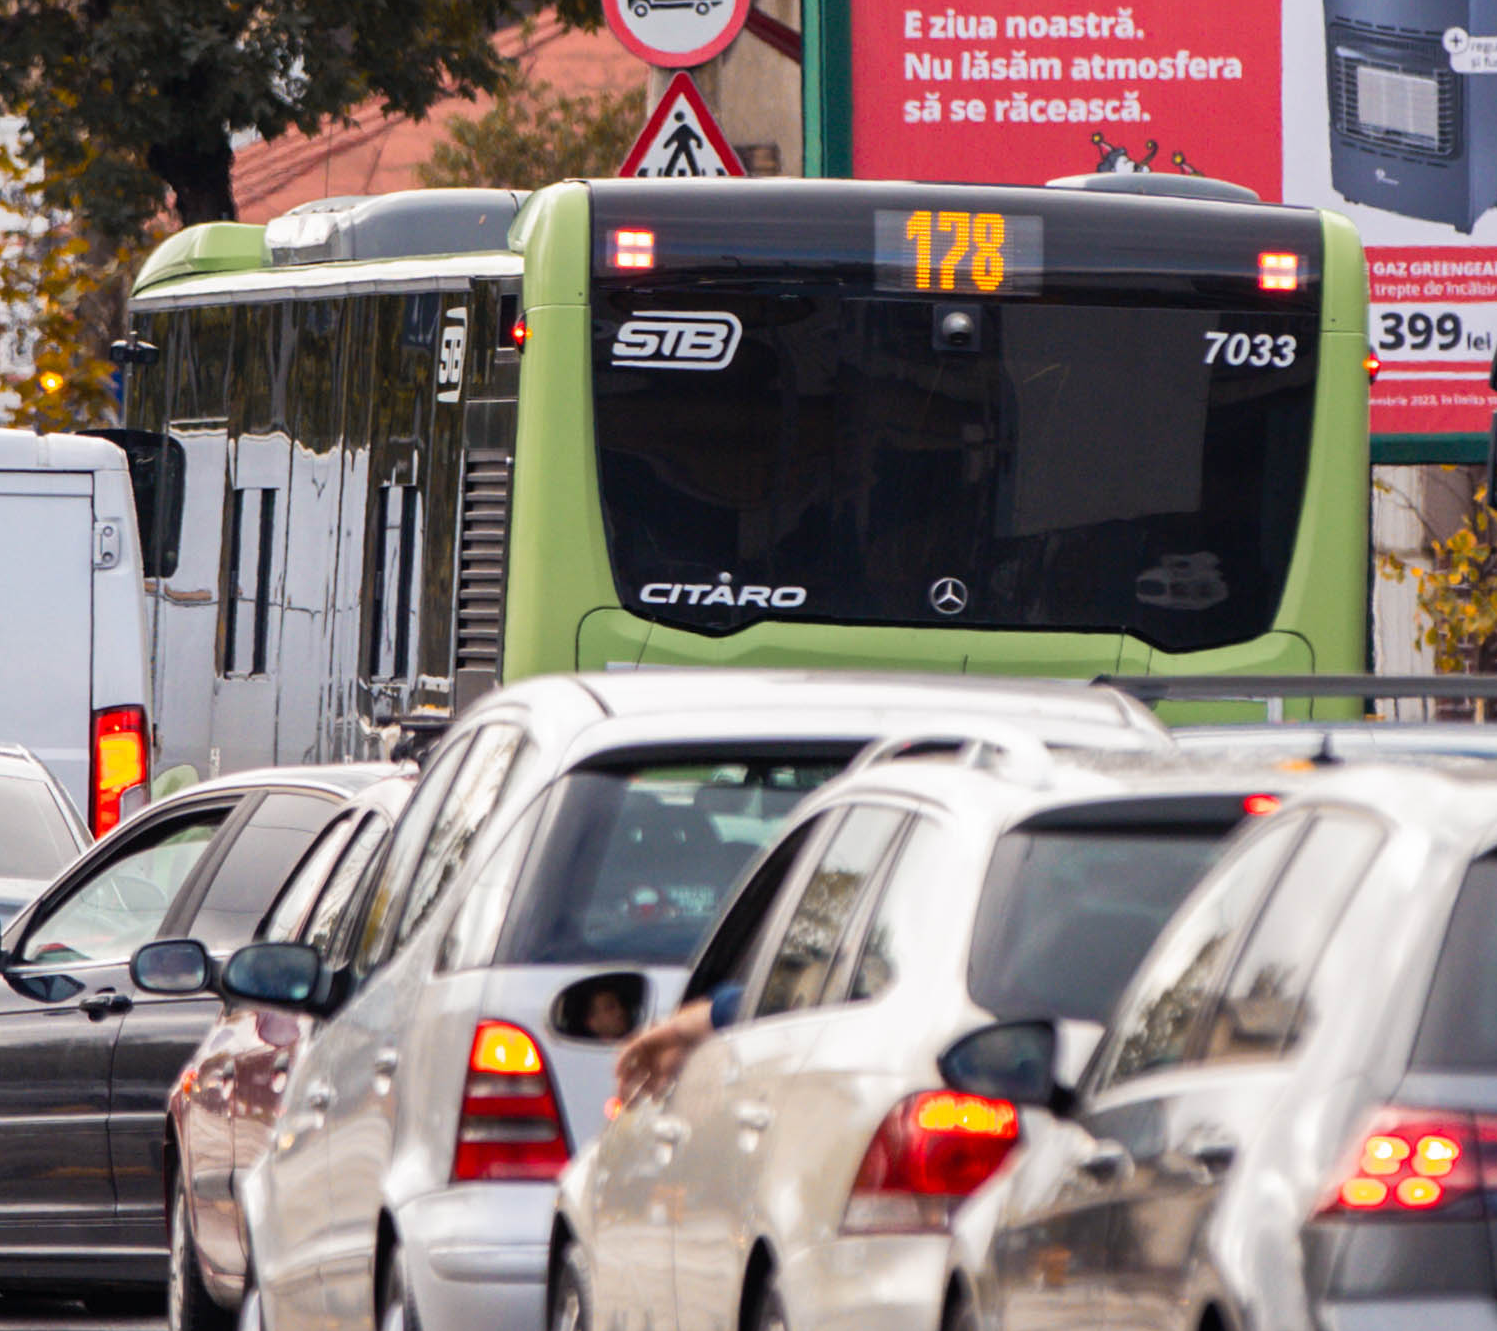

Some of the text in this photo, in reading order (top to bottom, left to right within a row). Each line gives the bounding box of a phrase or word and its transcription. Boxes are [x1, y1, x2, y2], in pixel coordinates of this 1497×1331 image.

[904, 7, 1145, 39] E ziua noastră.
[904, 50, 1243, 81] Nu lăsăm atmosfera
[904, 91, 1151, 122] să se răcească.
[906, 211, 1006, 292] 178
[1373, 261, 1407, 276] GAZ
[1374, 283, 1420, 299] trepte
[1424, 281, 1443, 296] de
[611, 320, 731, 360] STB
[1378, 312, 1492, 351] 399 lei
[1203, 331, 1298, 368] 7033
[638, 582, 808, 608] CITARO
